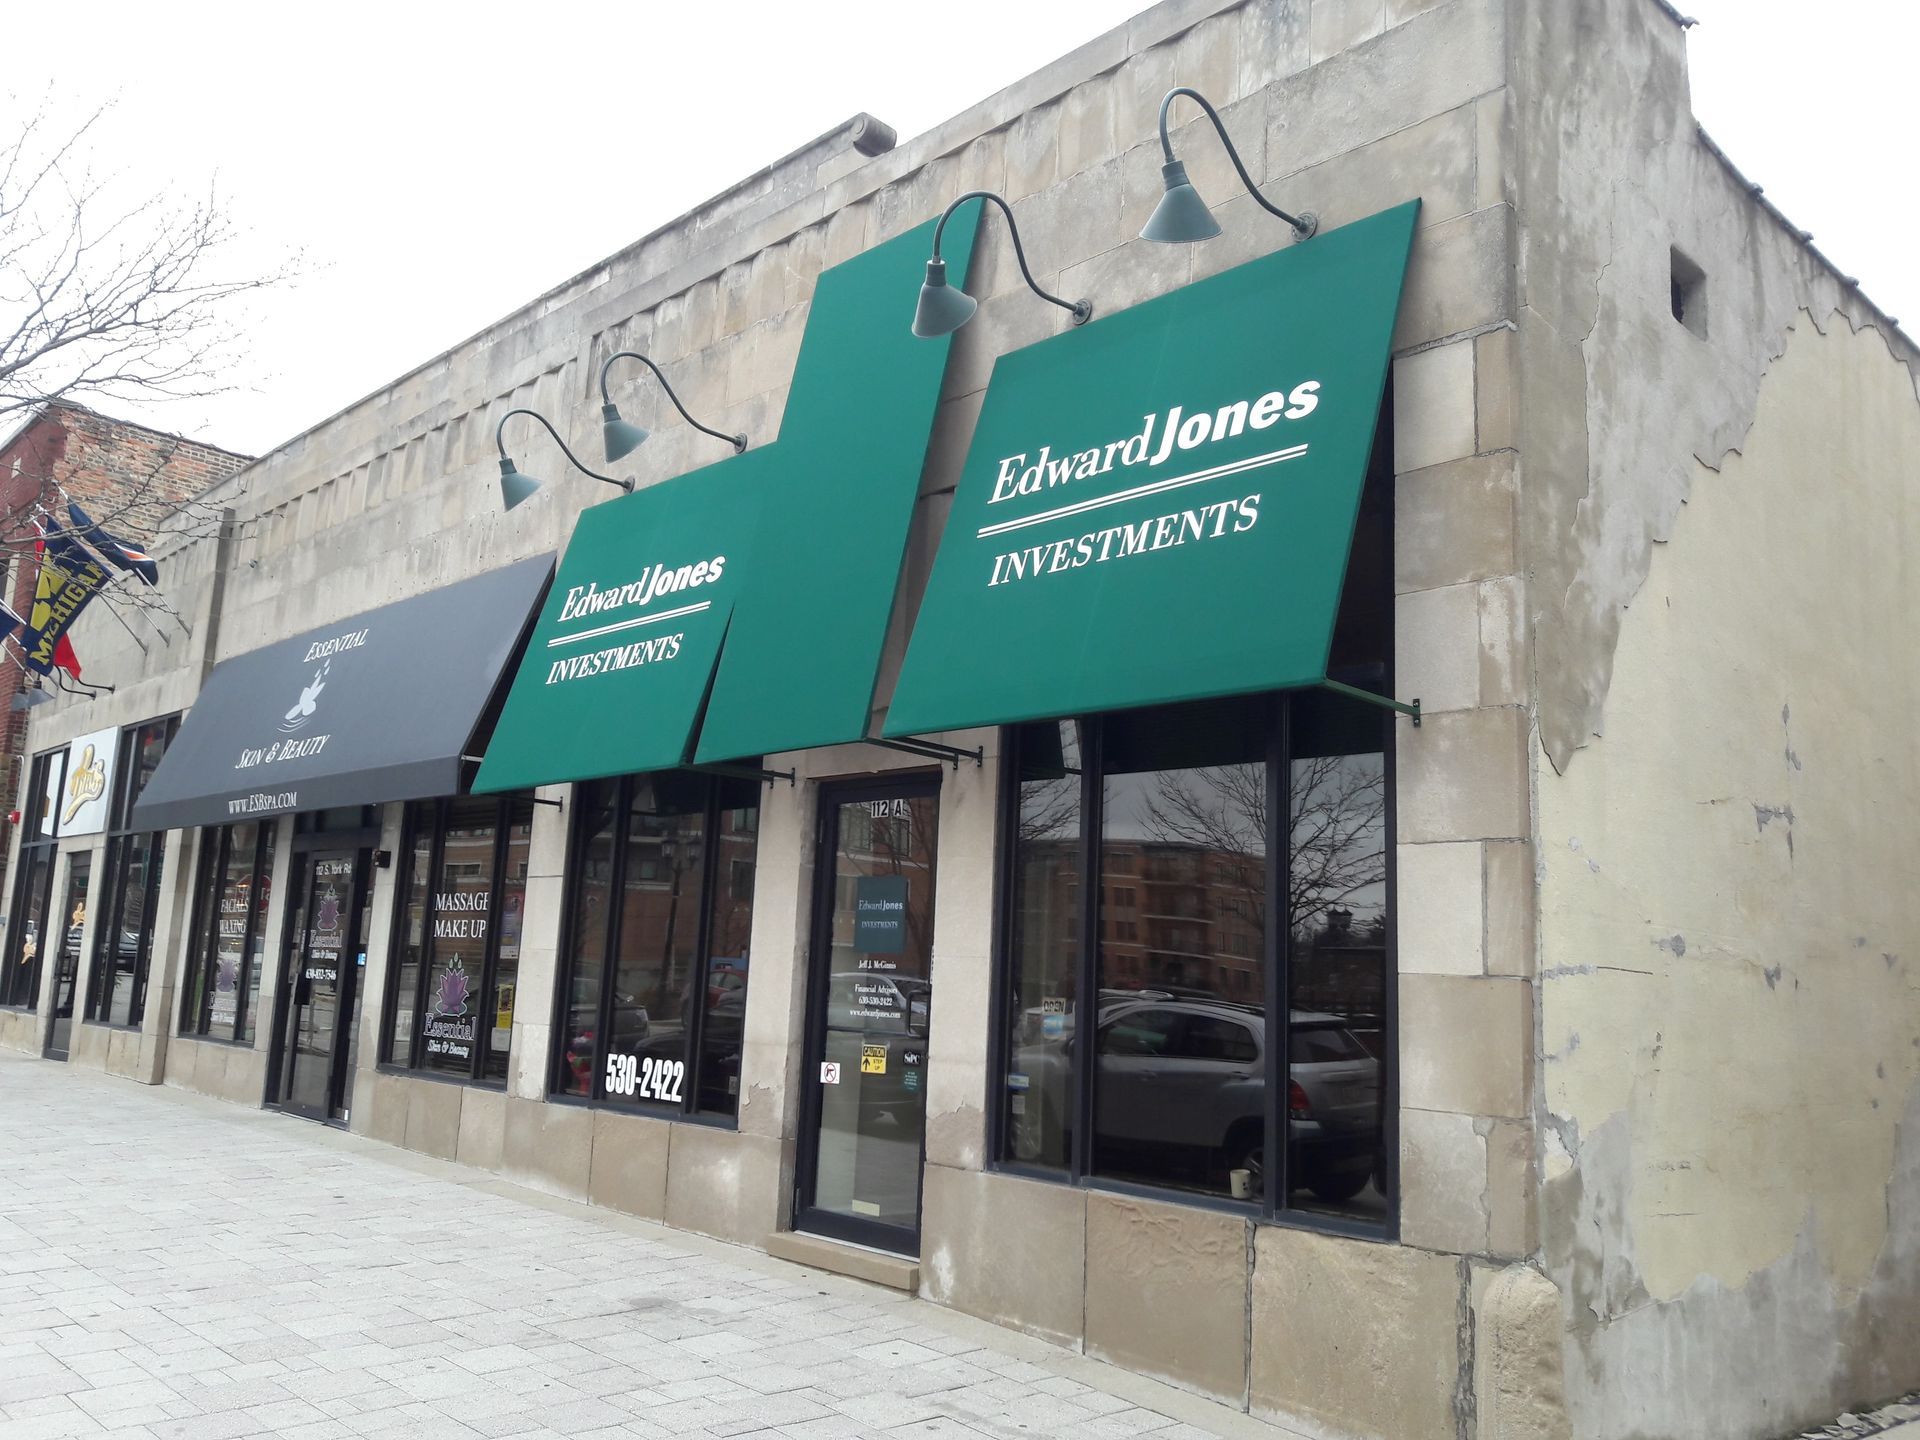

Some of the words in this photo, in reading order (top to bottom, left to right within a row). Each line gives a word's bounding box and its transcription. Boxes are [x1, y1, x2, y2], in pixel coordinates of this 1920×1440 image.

[987, 494, 1261, 587] INVESTMENTS
[303, 629, 369, 663] ESSENTIAL
[545, 633, 684, 684] INVESTMENTS
[235, 748, 268, 769] SKIN
[265, 741, 281, 764] &
[277, 734, 331, 761] BEAUTY
[872, 801, 889, 817] 112
[894, 801, 902, 816] A
[434, 920, 468, 938] MAKE
[470, 920, 487, 938] UP
[854, 983, 877, 993] Financial
[1043, 1000, 1065, 1012] OPEN
[423, 1012, 477, 1041] Essential
[863, 1047, 885, 1057] CAUTION
[605, 1053, 685, 1103] 530-2422
